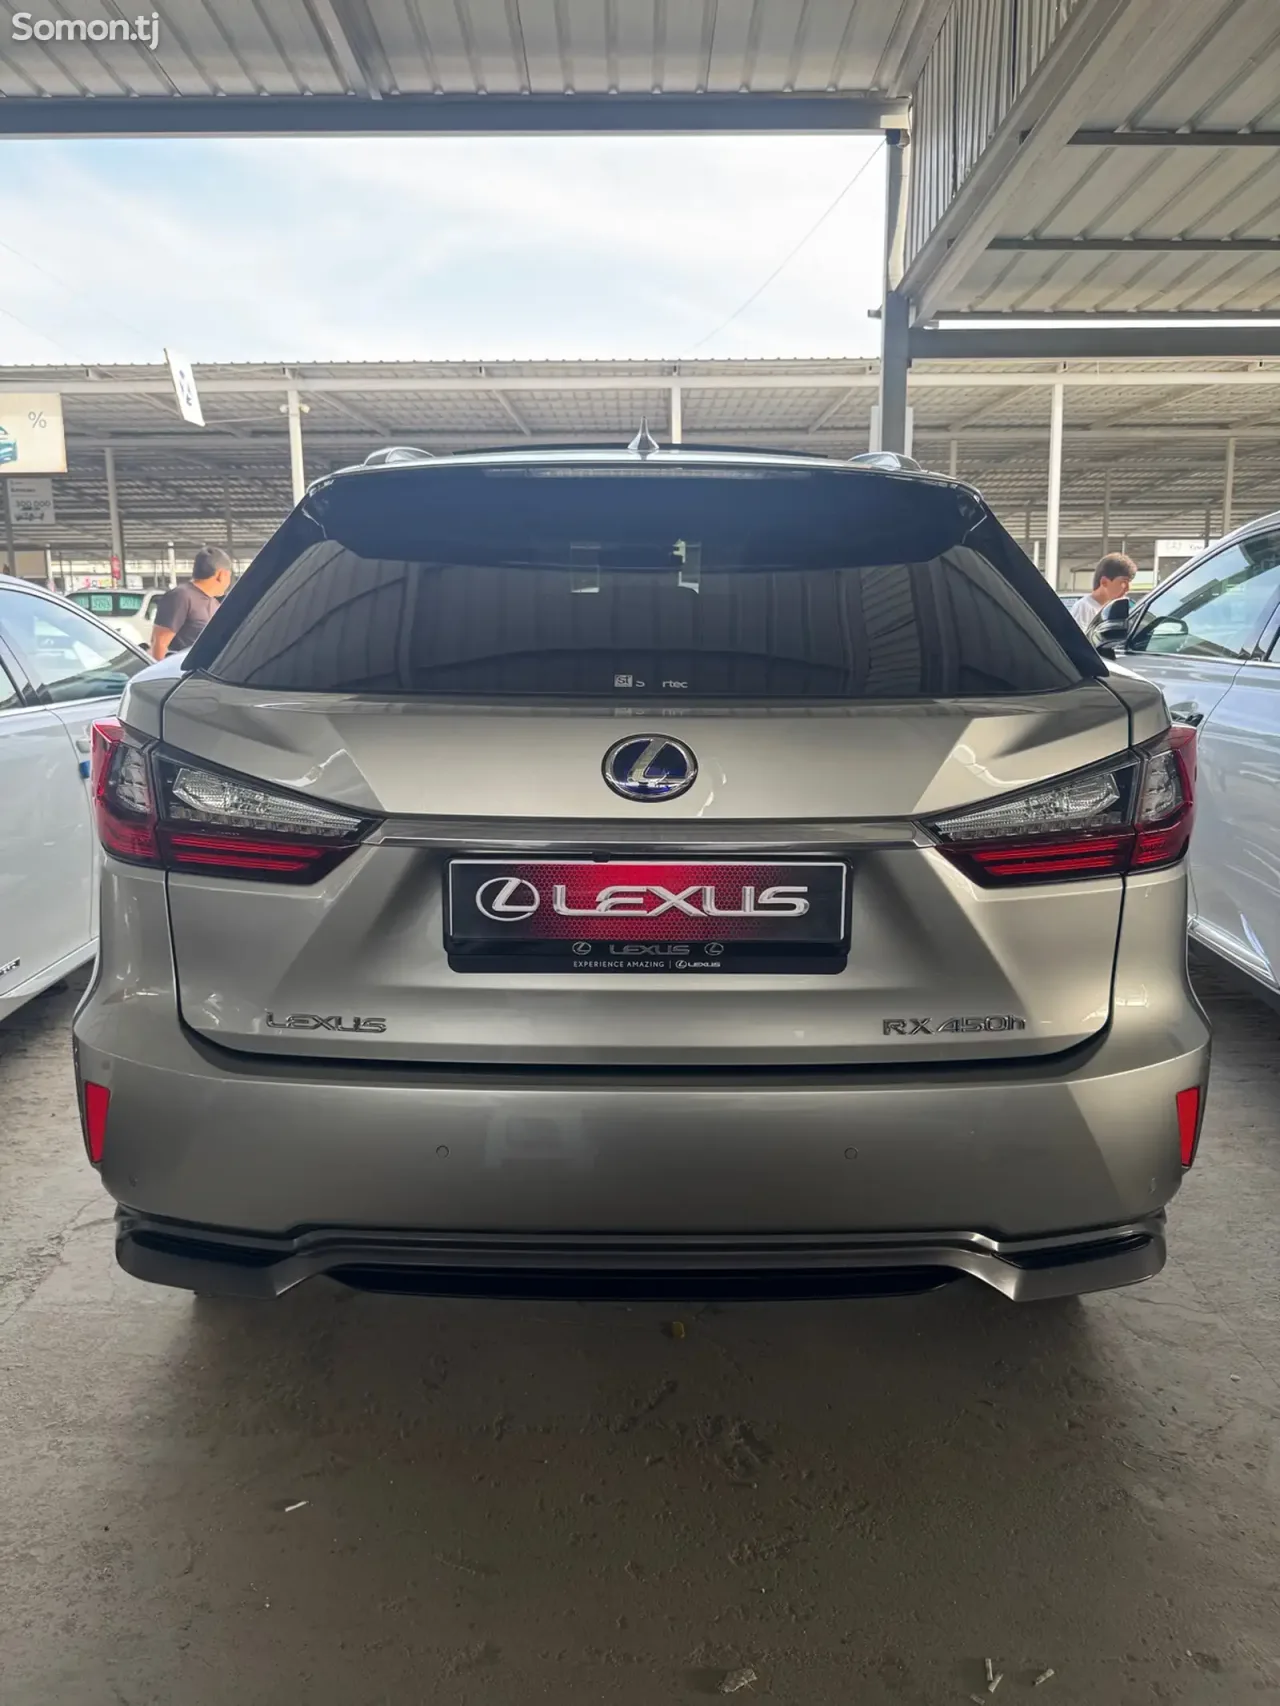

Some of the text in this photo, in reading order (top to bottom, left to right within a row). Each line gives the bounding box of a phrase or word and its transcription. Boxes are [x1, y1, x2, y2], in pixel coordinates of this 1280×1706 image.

[553, 884, 810, 917] LEXUS
[609, 944, 690, 955] LEXUS
[266, 1011, 387, 1034] LEXUS
[883, 1014, 1026, 1035] RX 450h
